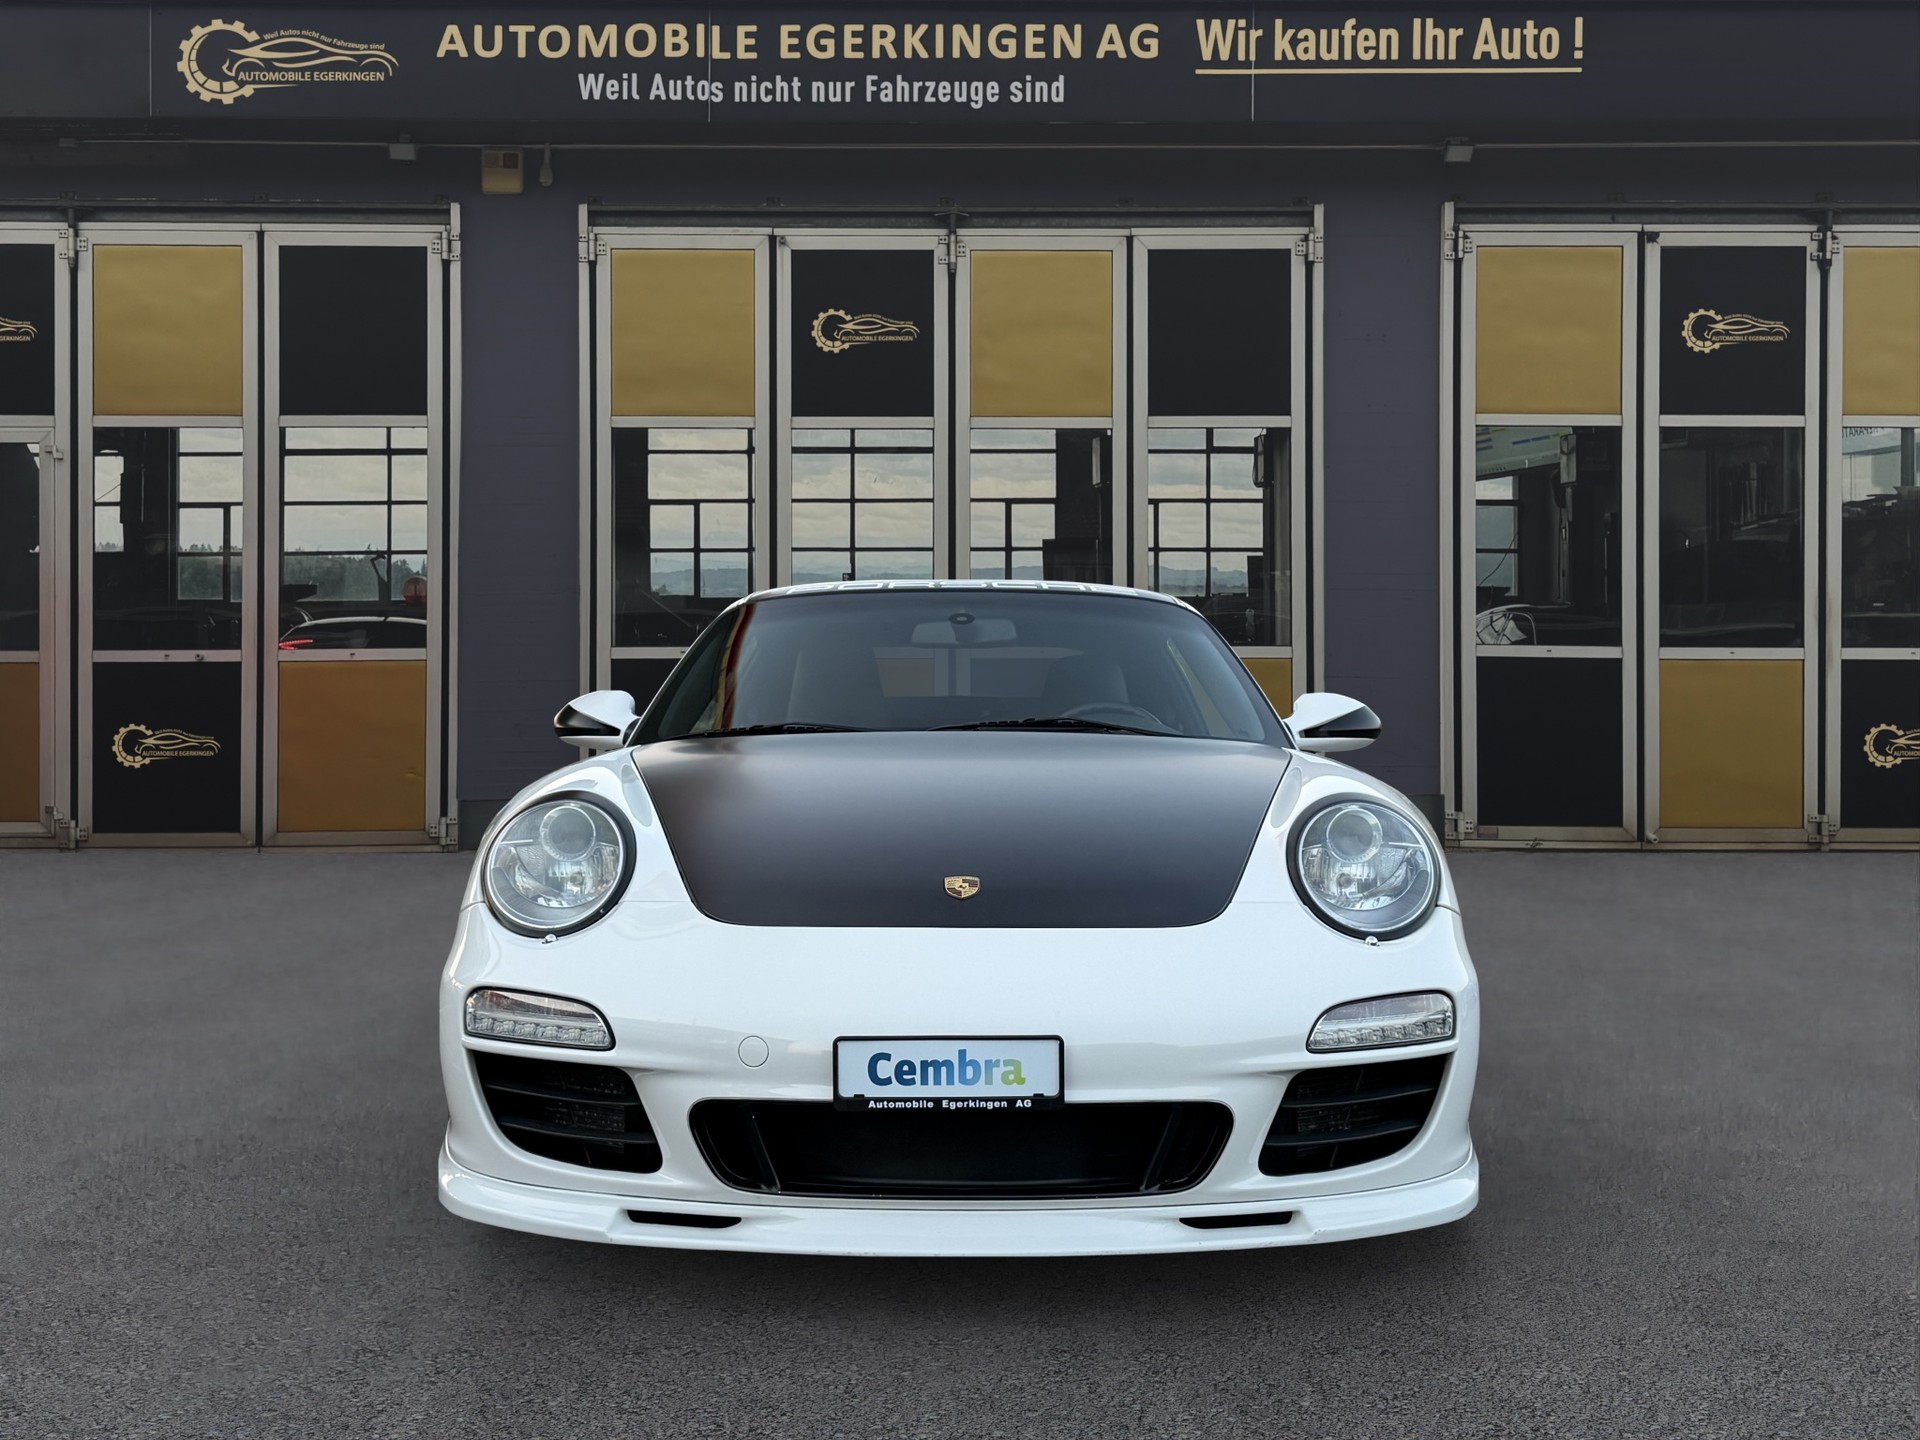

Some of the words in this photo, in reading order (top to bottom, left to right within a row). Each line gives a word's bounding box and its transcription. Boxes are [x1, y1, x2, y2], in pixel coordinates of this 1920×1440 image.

[263, 31, 279, 40] Weil
[301, 29, 320, 39] nicht
[320, 35, 333, 43] nur
[333, 38, 369, 50] Fahrzeuge
[436, 23, 758, 60] AUTOMOBILE
[780, 23, 1082, 59] EGERKINGEN
[1095, 23, 1159, 59] AG
[1196, 18, 1263, 61] Wir
[1274, 18, 1399, 61] kaufen
[1412, 17, 1463, 60] Ihr
[1472, 17, 1560, 60] Auto
[238, 71, 311, 82] AUTOMOBILE
[313, 71, 385, 82] EGERKINGEN
[578, 73, 640, 100] Weil
[650, 73, 724, 103] Autos
[734, 74, 802, 103] nicht
[811, 81, 856, 103] nur
[866, 74, 1000, 109] Fahrzeuge
[1009, 74, 1065, 103] sind
[867, 1048, 1026, 1087] Cembra
[868, 1100, 934, 1108] Automobile
[942, 1100, 1008, 1109] Egerkingen
[1015, 1099, 1032, 1108] AG
